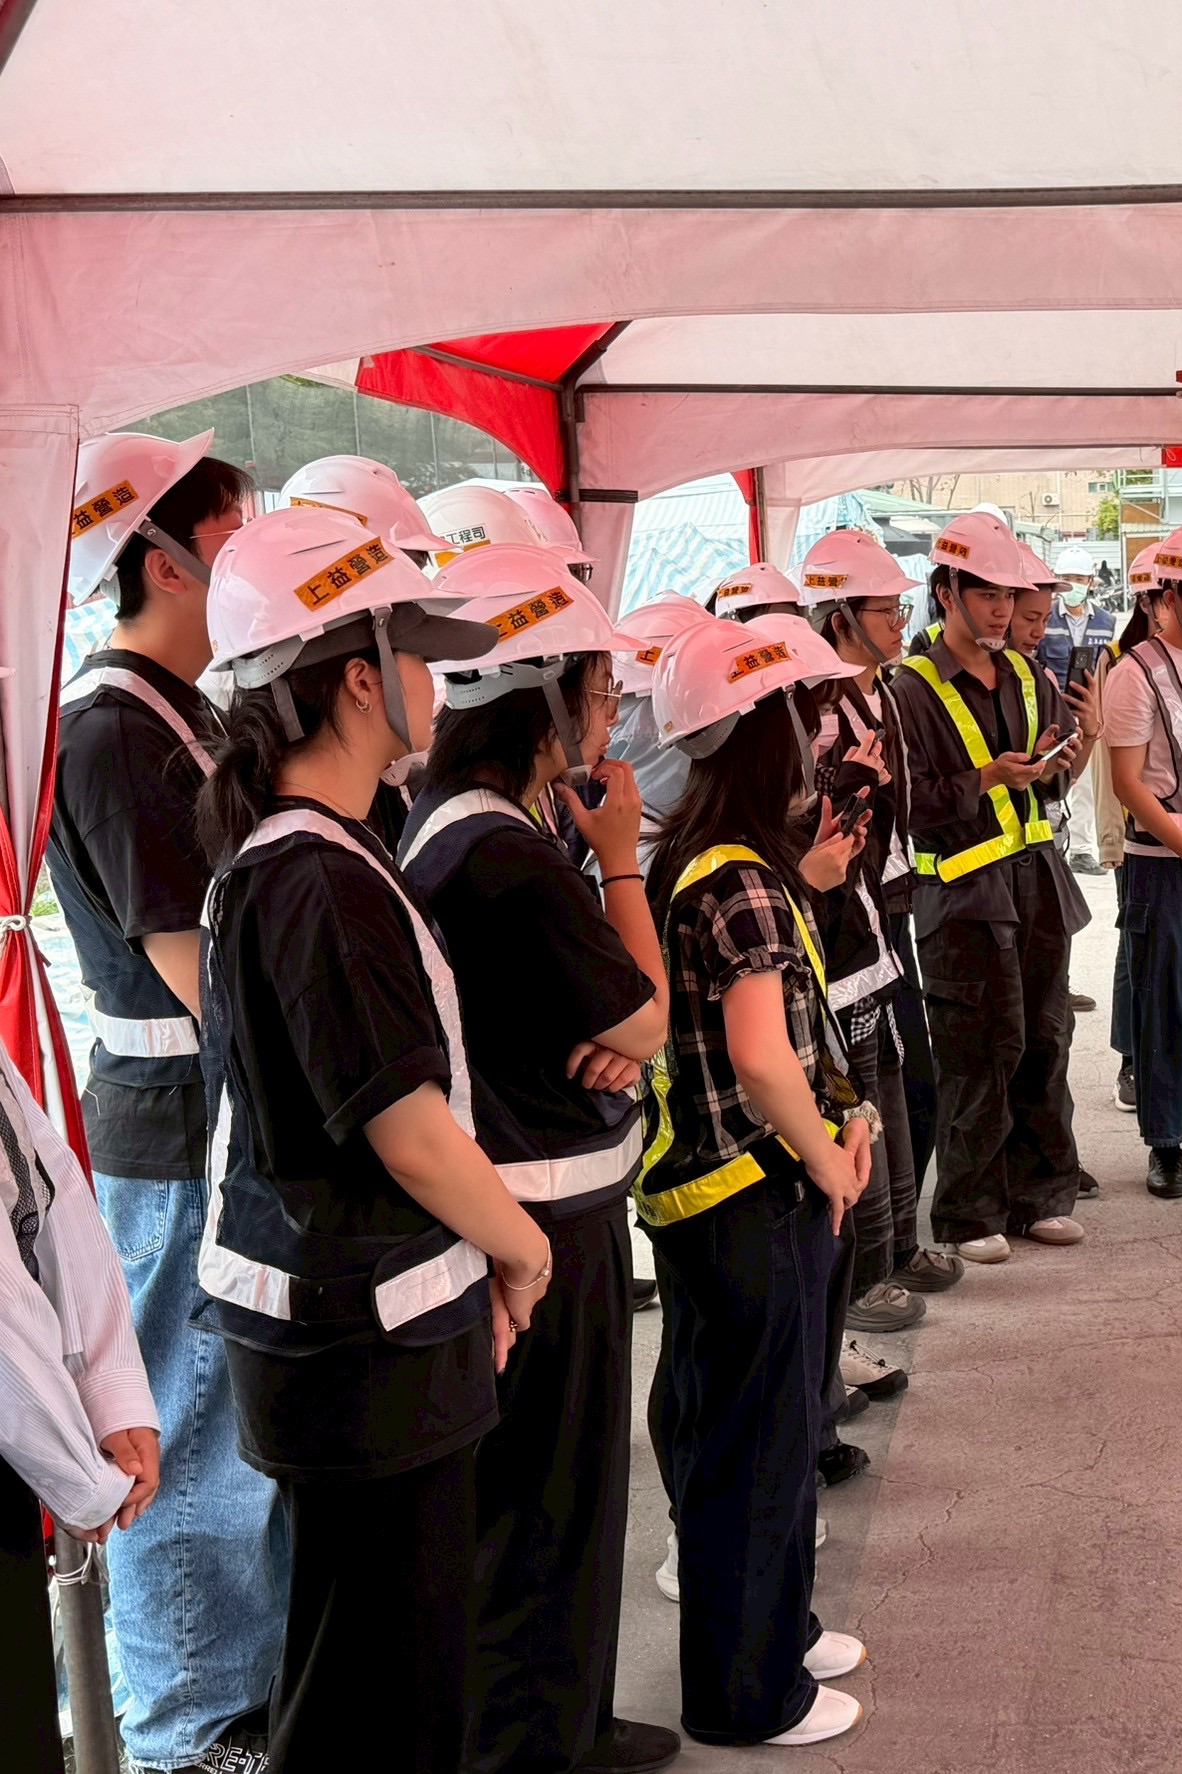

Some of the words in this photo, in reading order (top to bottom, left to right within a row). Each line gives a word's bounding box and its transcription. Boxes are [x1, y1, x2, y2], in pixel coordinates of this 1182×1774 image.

[73, 486, 135, 535] 益營造
[440, 526, 486, 545] 工程司
[307, 543, 389, 605] 上益營造
